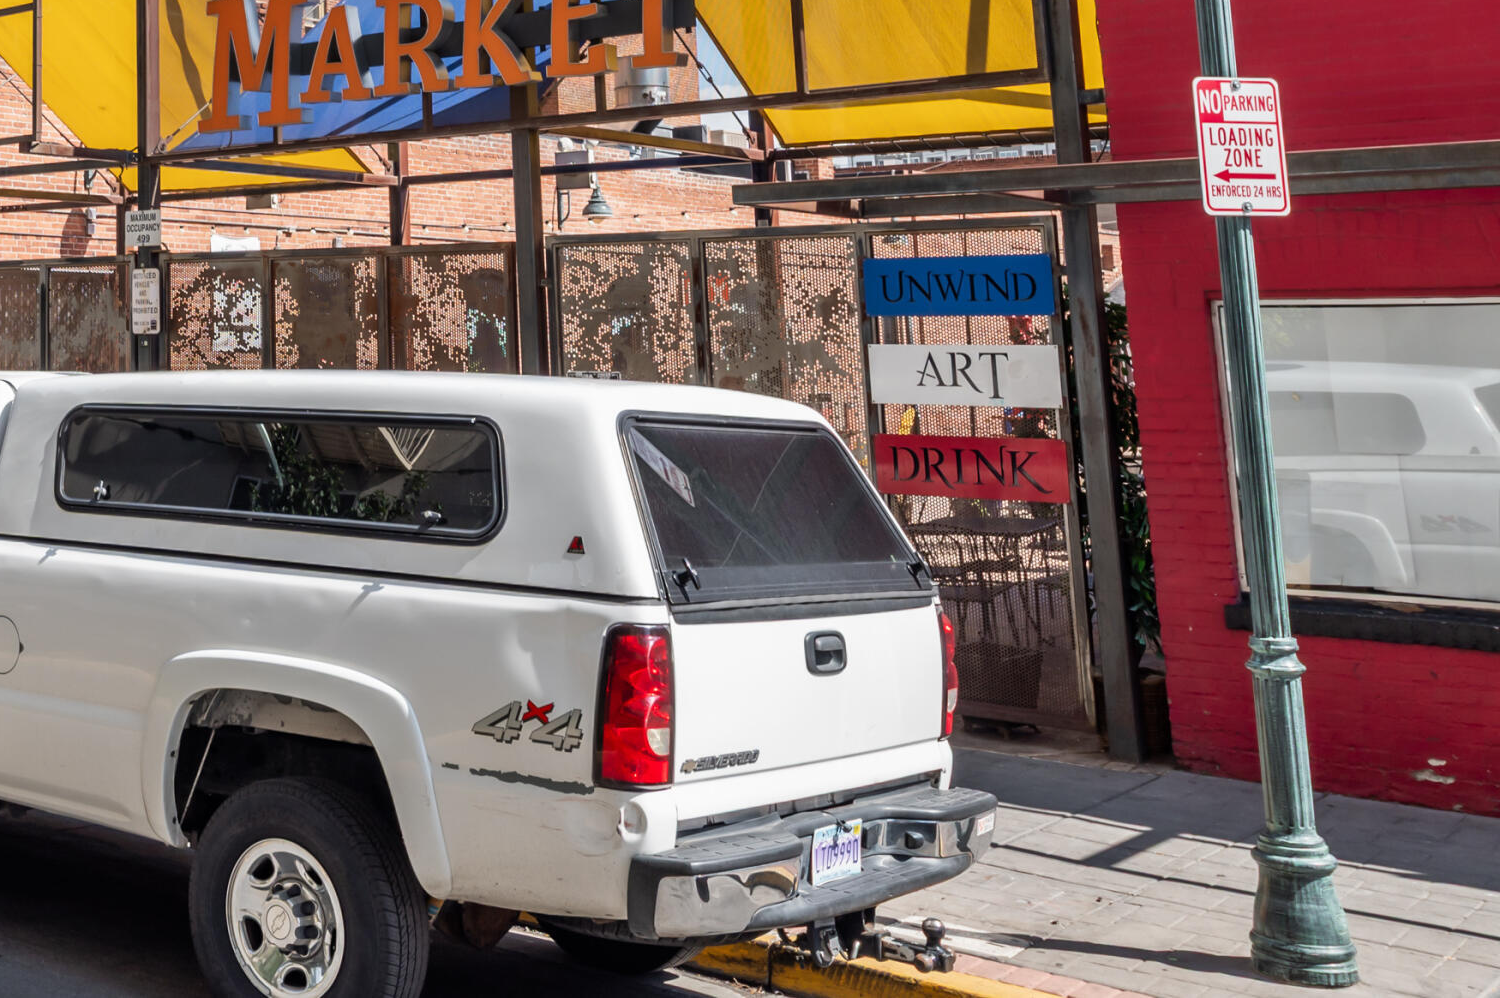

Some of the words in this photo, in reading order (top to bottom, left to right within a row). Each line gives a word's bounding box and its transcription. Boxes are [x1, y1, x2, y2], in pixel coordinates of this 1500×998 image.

[1198, 89, 1221, 115] NO
[1223, 95, 1274, 113] PARKING
[1209, 126, 1274, 148] LOADING
[1223, 148, 1263, 168] ZONE
[1211, 185, 1252, 198] ENFORCED
[1253, 186, 1264, 198] 24
[1266, 186, 1282, 198] HRS
[126, 223, 160, 233] OCCUPANCY
[130, 213, 157, 222] MAXIMUM
[137, 234, 150, 243] 499
[879, 268, 1038, 303] UNWIND
[916, 351, 1009, 400] ART
[888, 445, 1053, 495] DRINK
[694, 749, 760, 772] SILVERADO
